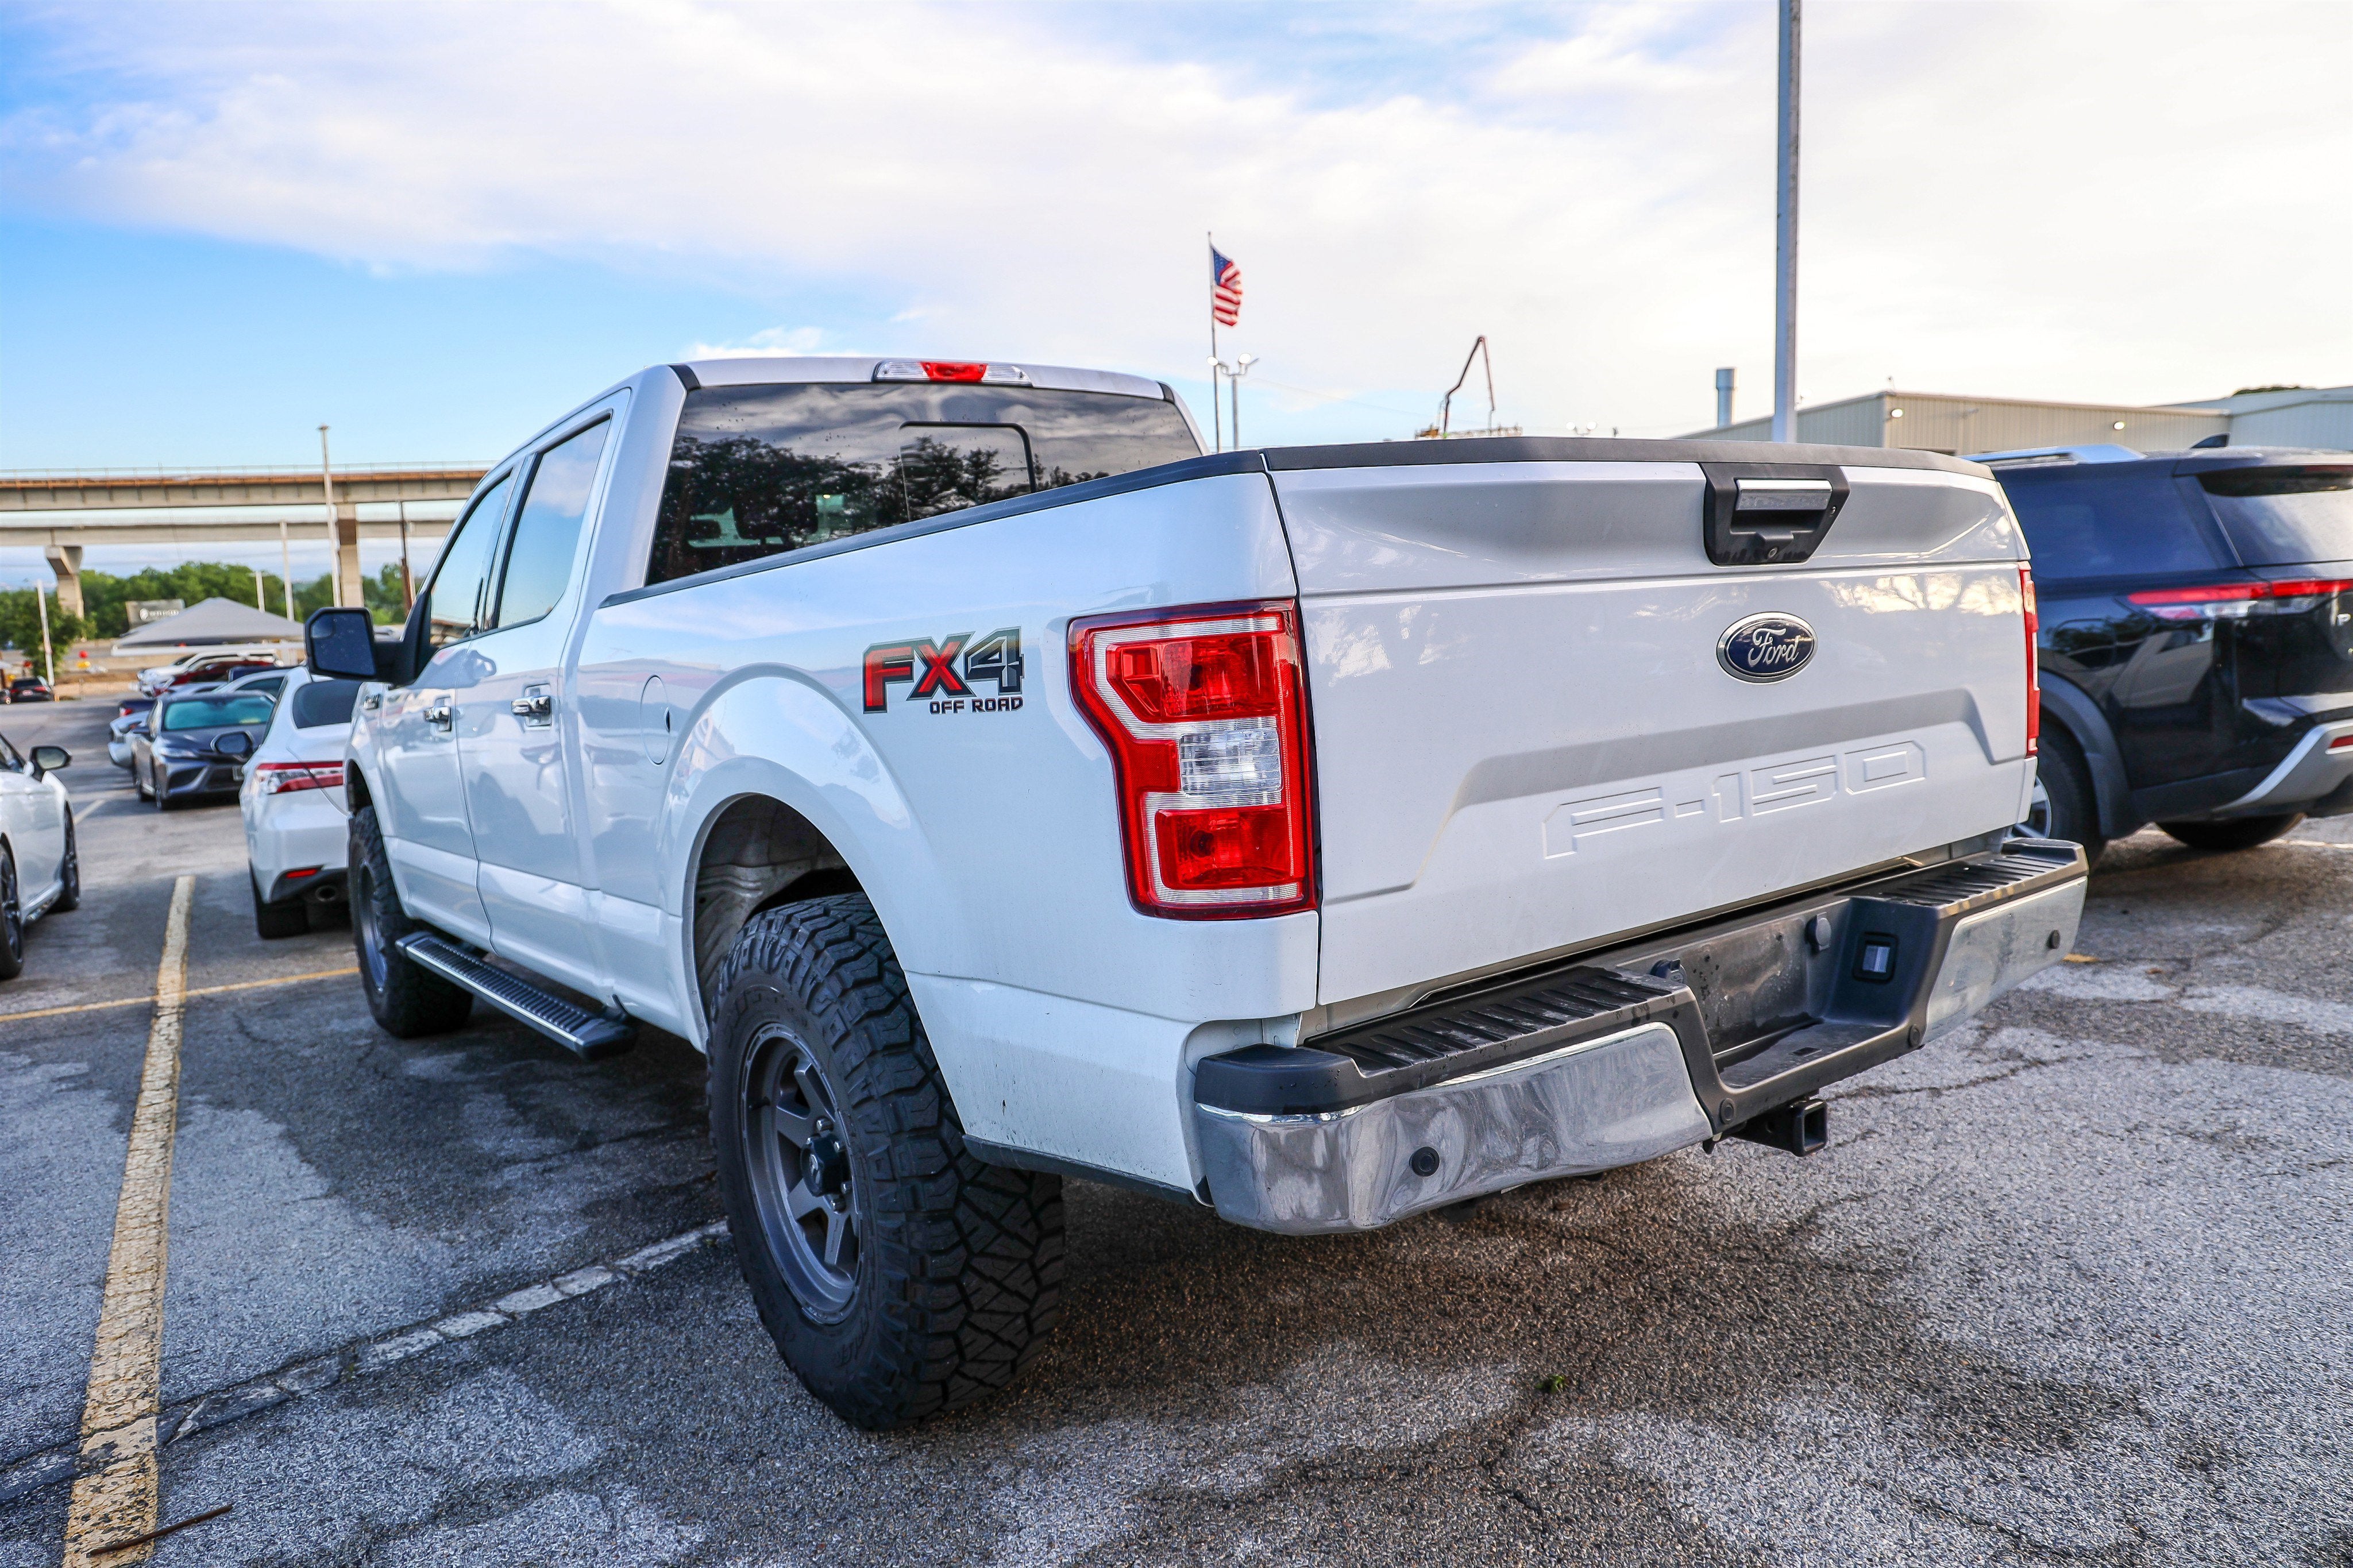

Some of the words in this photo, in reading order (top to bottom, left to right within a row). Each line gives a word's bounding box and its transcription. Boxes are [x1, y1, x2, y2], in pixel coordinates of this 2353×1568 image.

[862, 625, 1024, 714] FX4
[1748, 628, 1800, 667] Ford
[929, 700, 965, 715] OFF
[971, 696, 1024, 713] ROAD
[1542, 740, 1926, 860] F-150
